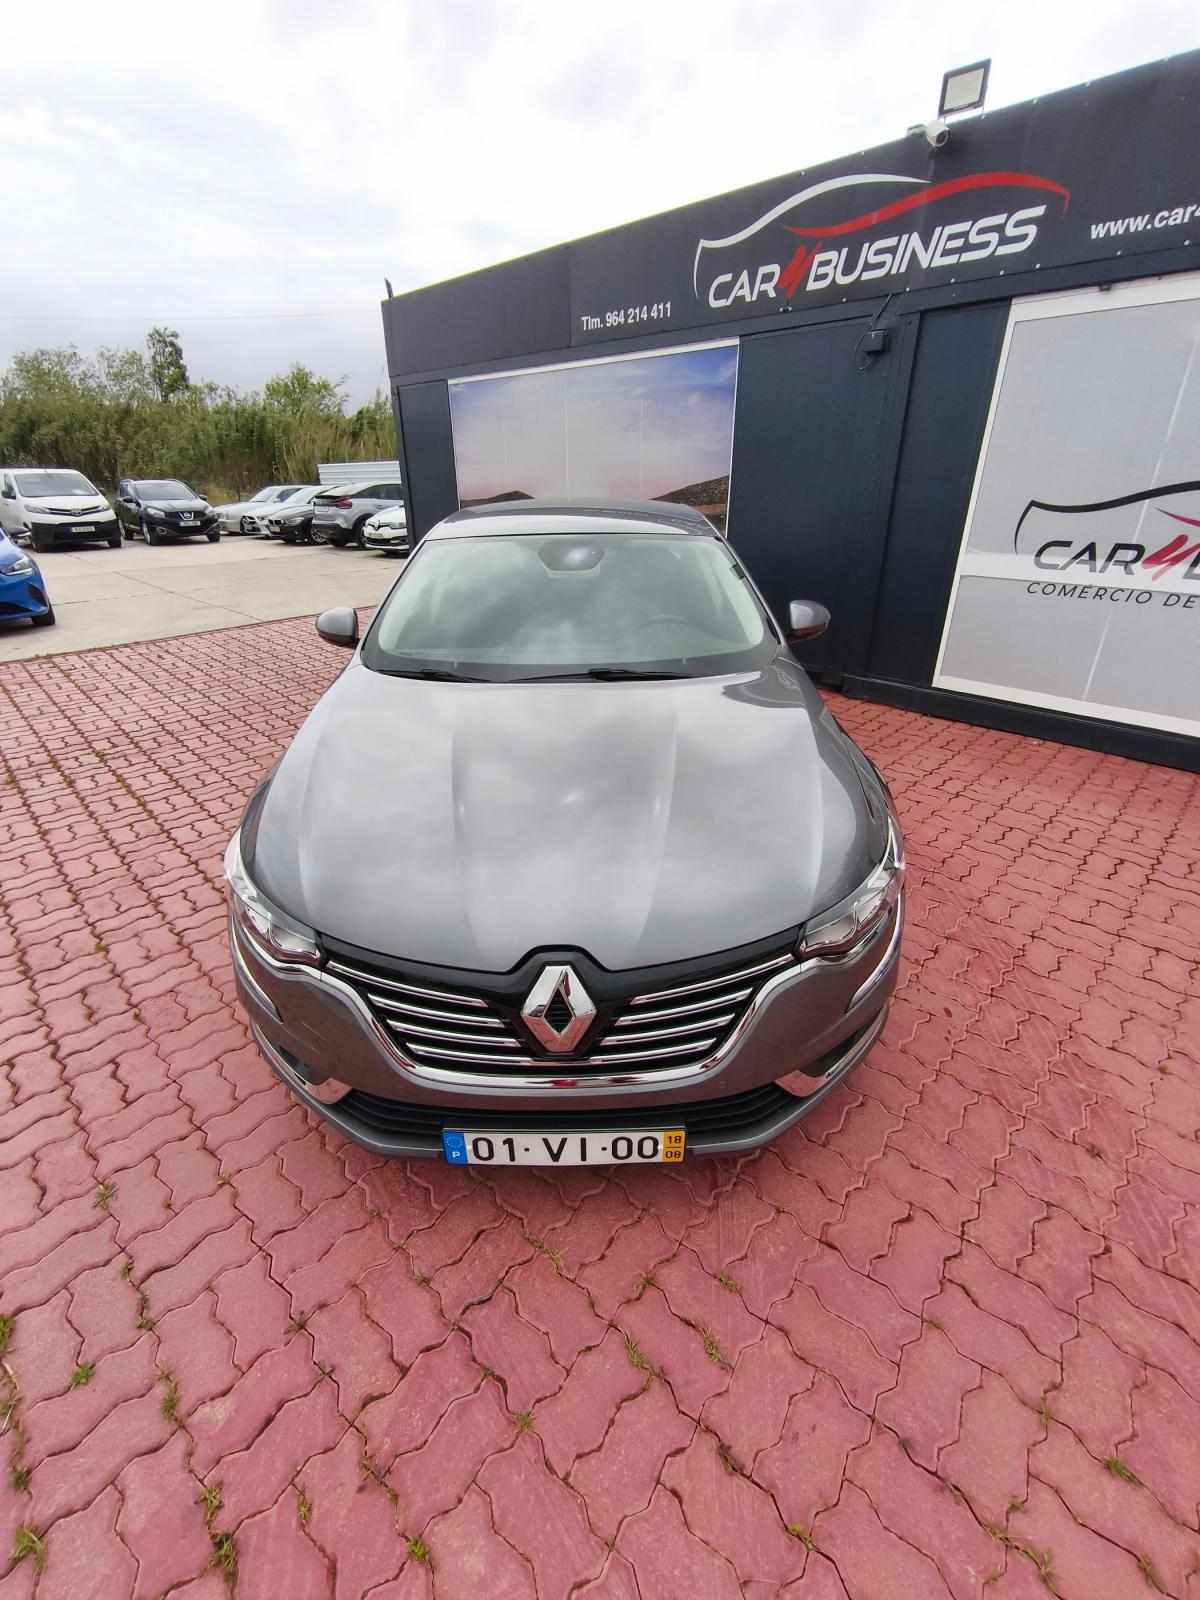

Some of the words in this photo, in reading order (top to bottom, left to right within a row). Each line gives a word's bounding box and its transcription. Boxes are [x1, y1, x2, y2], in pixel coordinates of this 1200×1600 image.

[605, 309, 625, 327] 964
[627, 305, 648, 323] 214
[650, 301, 671, 319] 411
[1026, 582, 1153, 605] COMERCIO
[1162, 593, 1200, 609] DE
[667, 1135, 682, 1145] 18
[665, 1150, 681, 1159] 08
